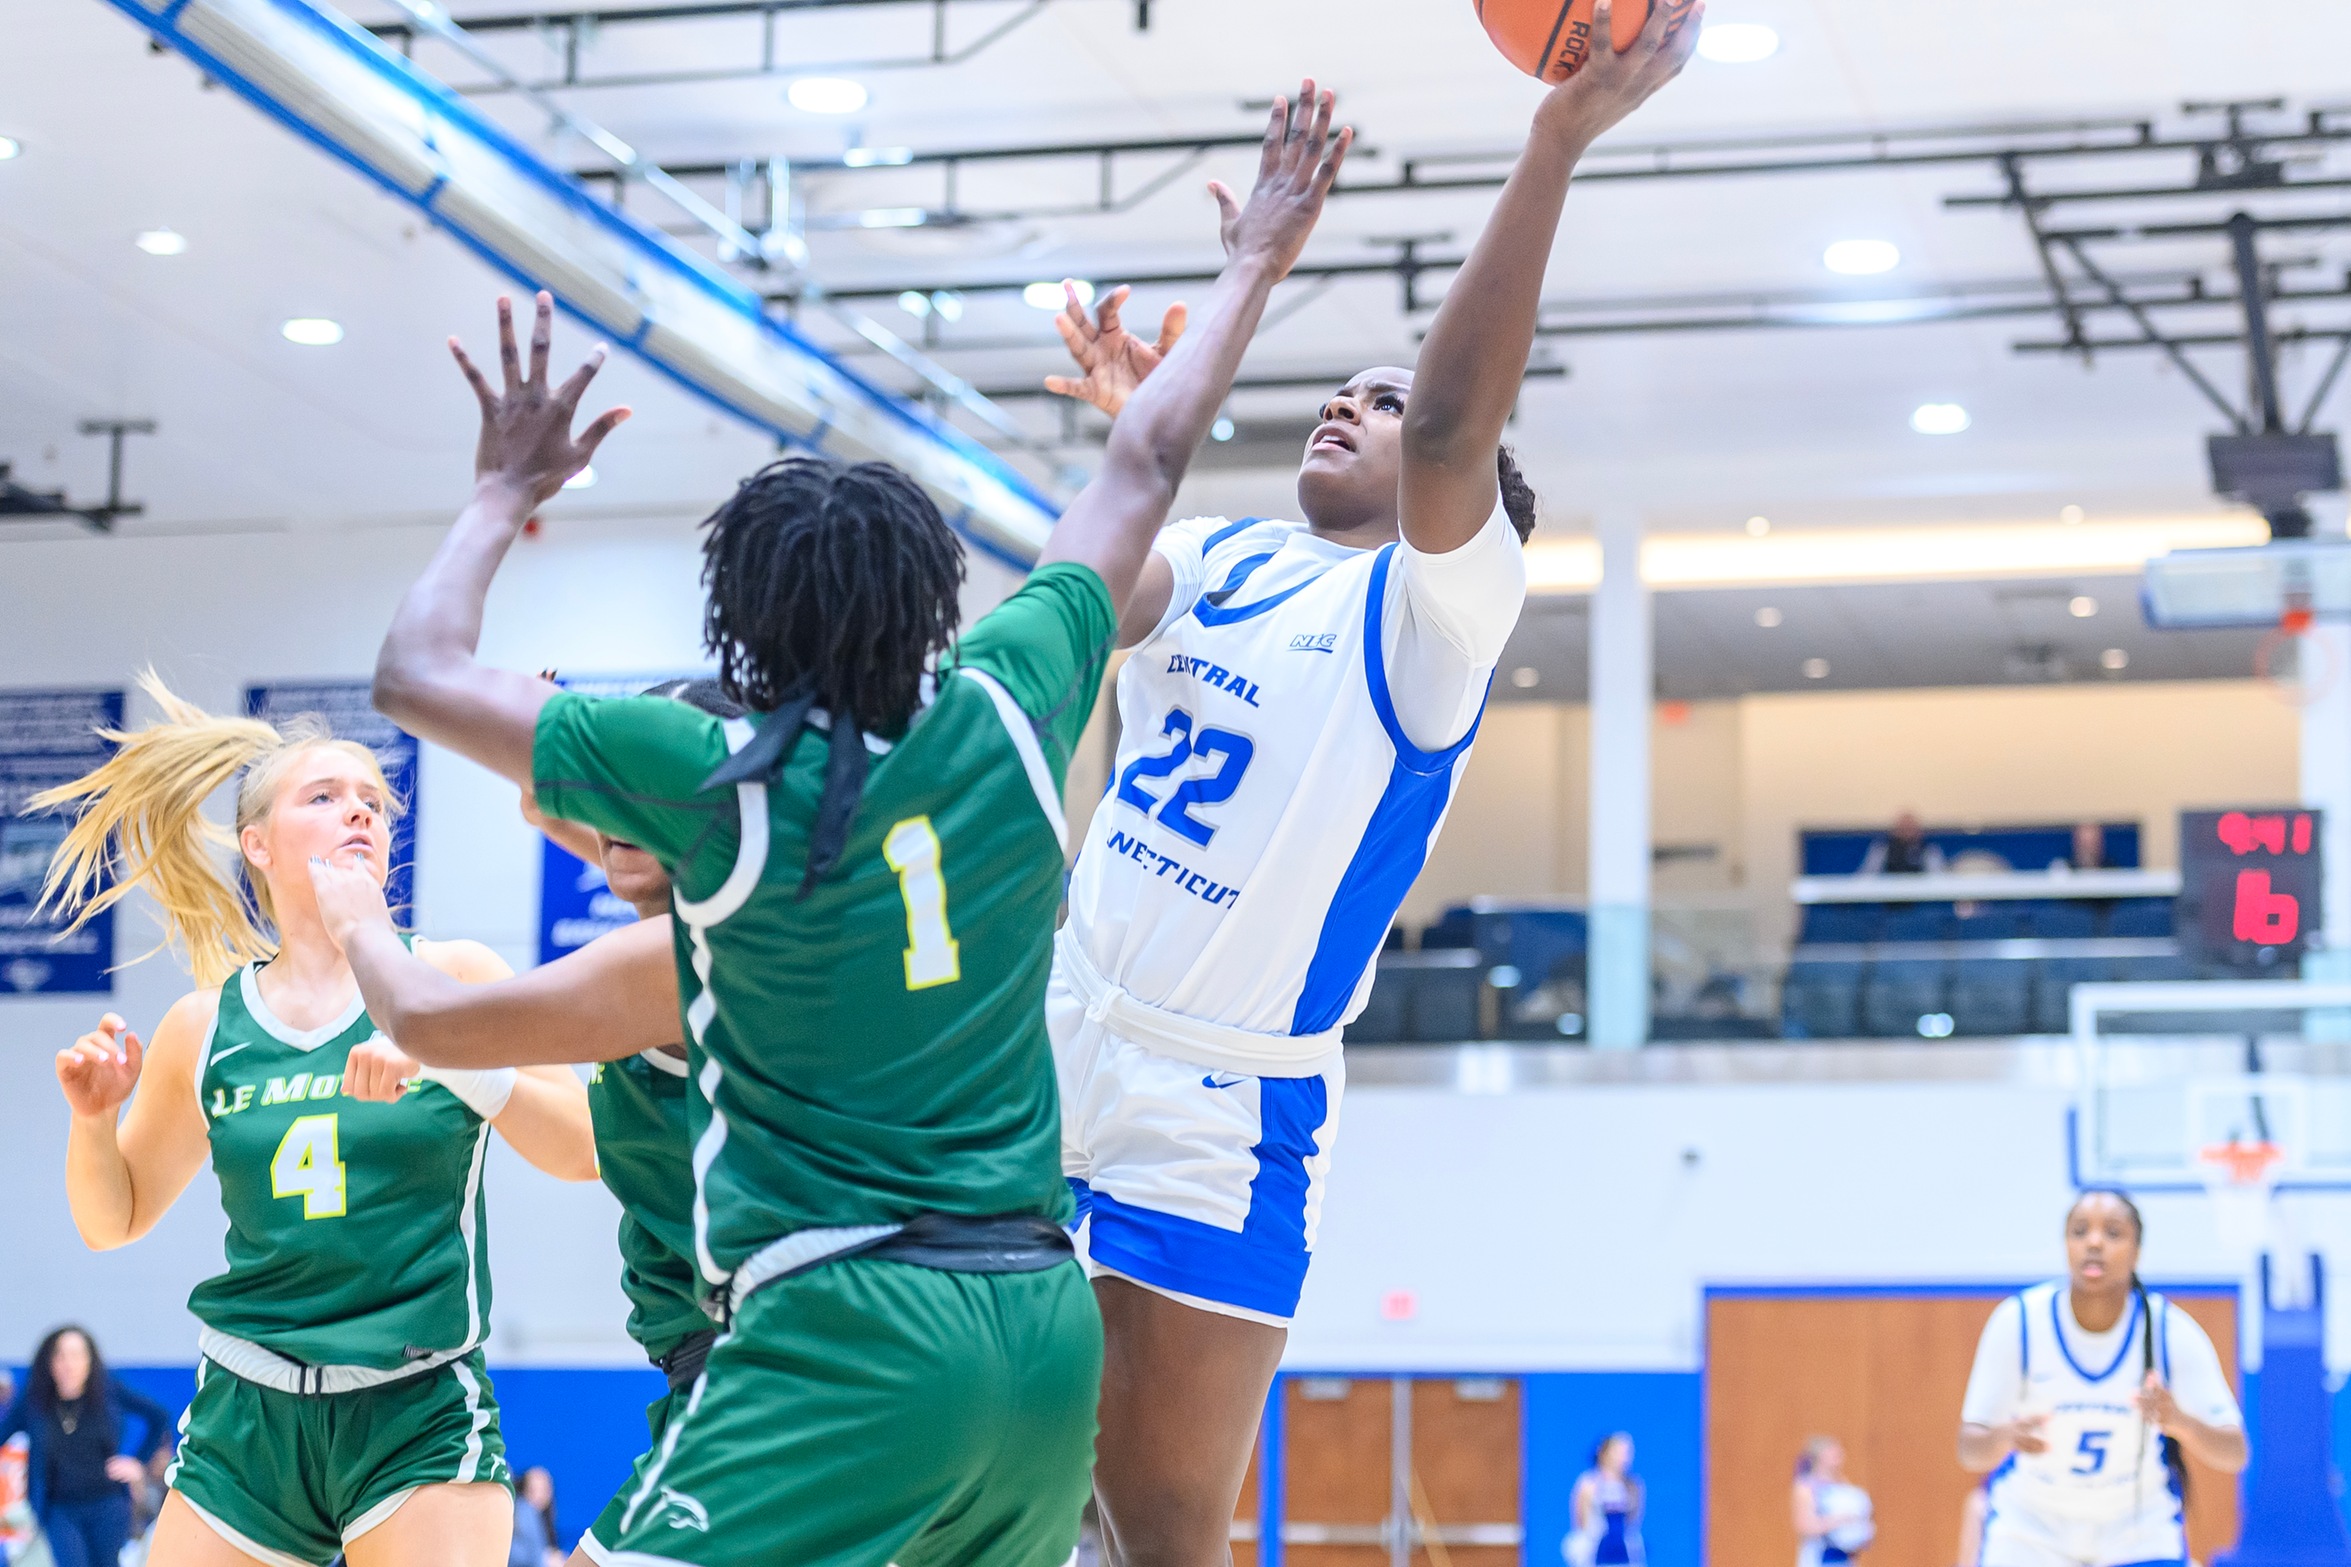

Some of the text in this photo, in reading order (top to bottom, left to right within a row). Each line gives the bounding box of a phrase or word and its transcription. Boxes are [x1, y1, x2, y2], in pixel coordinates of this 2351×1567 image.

[1289, 633, 1338, 648] NEC
[1166, 654, 1260, 708] CENTRAL
[1115, 705, 1256, 852] 22
[881, 813, 961, 991] 1
[210, 1084, 257, 1118] LE
[269, 1112, 347, 1220] 4
[2068, 1430, 2114, 1476] 5
